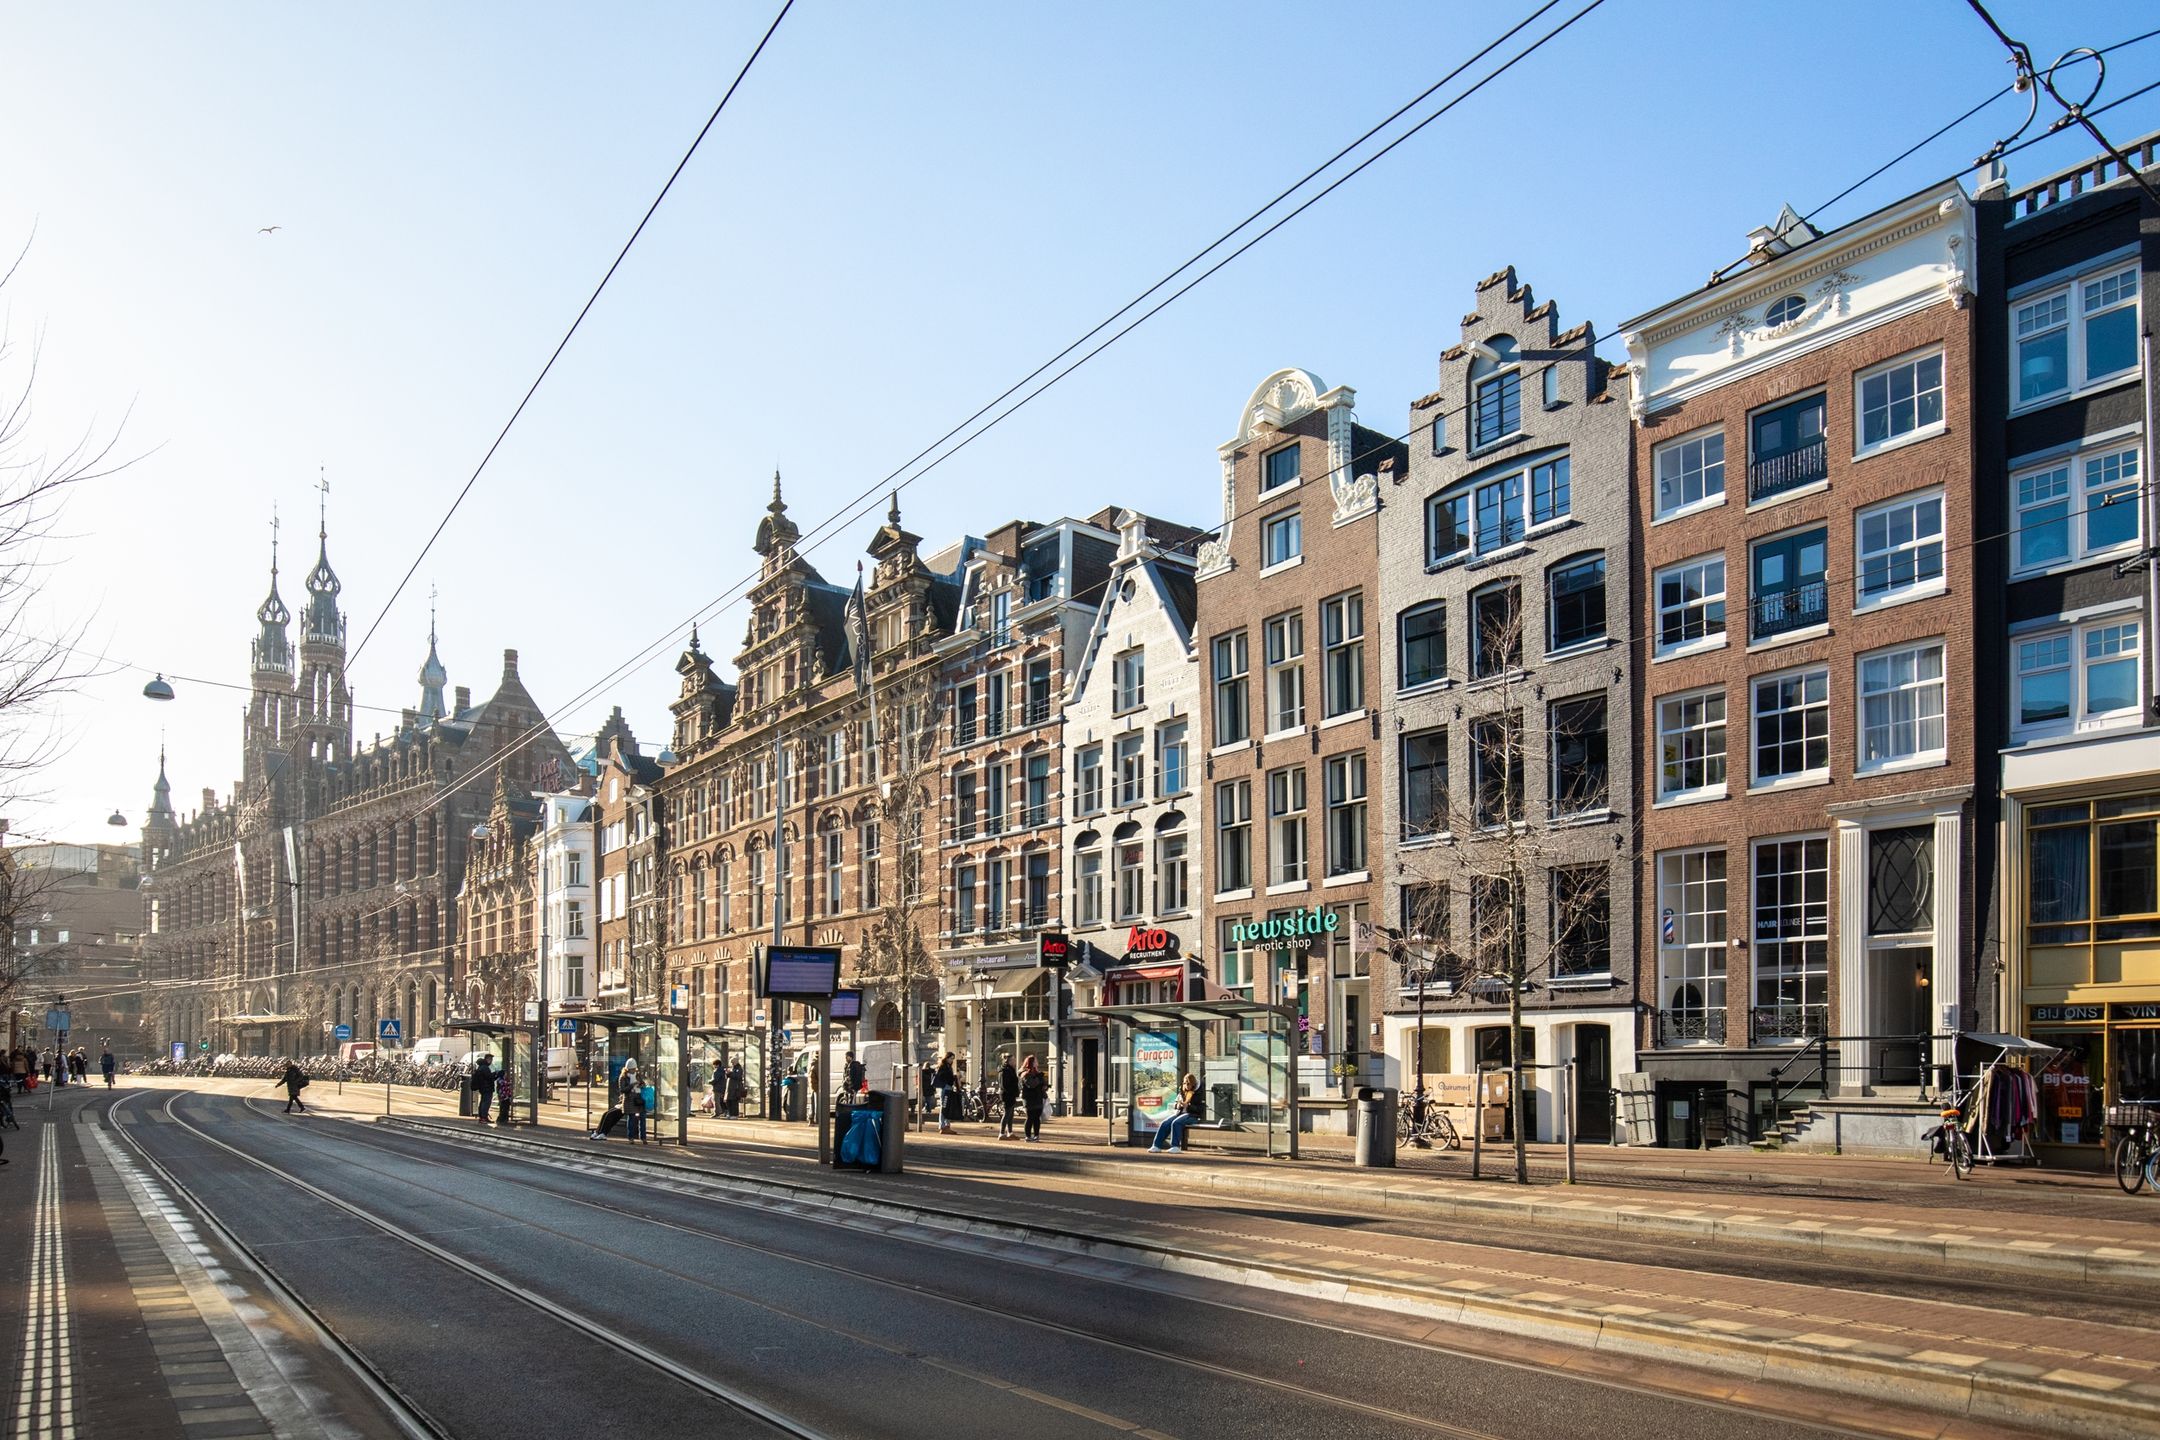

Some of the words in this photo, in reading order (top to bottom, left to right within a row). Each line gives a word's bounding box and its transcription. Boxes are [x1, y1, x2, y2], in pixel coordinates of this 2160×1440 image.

[1232, 905, 1338, 943] newside
[1757, 920, 1777, 929] HAIR
[1780, 917, 1802, 927] LOUNGE
[1042, 939, 1067, 953] Arto
[1127, 925, 1167, 953] Arto
[1255, 940, 1284, 952] erotic
[1286, 935, 1311, 950] shop
[949, 957, 964, 967] Hotel
[976, 954, 1006, 965] Restaurant
[1130, 949, 1166, 959] RECRUITMENT
[2037, 1007, 2059, 1019] BIJ
[2064, 1006, 2098, 1019] ONS
[2129, 1004, 2160, 1018] VIN
[1136, 1048, 1174, 1065] Curaçao
[1438, 1081, 1471, 1092] Quirumed
[2043, 1073, 2060, 1087] Bij
[2061, 1073, 2090, 1085] Ons
[2060, 1108, 2080, 1116] SALE
